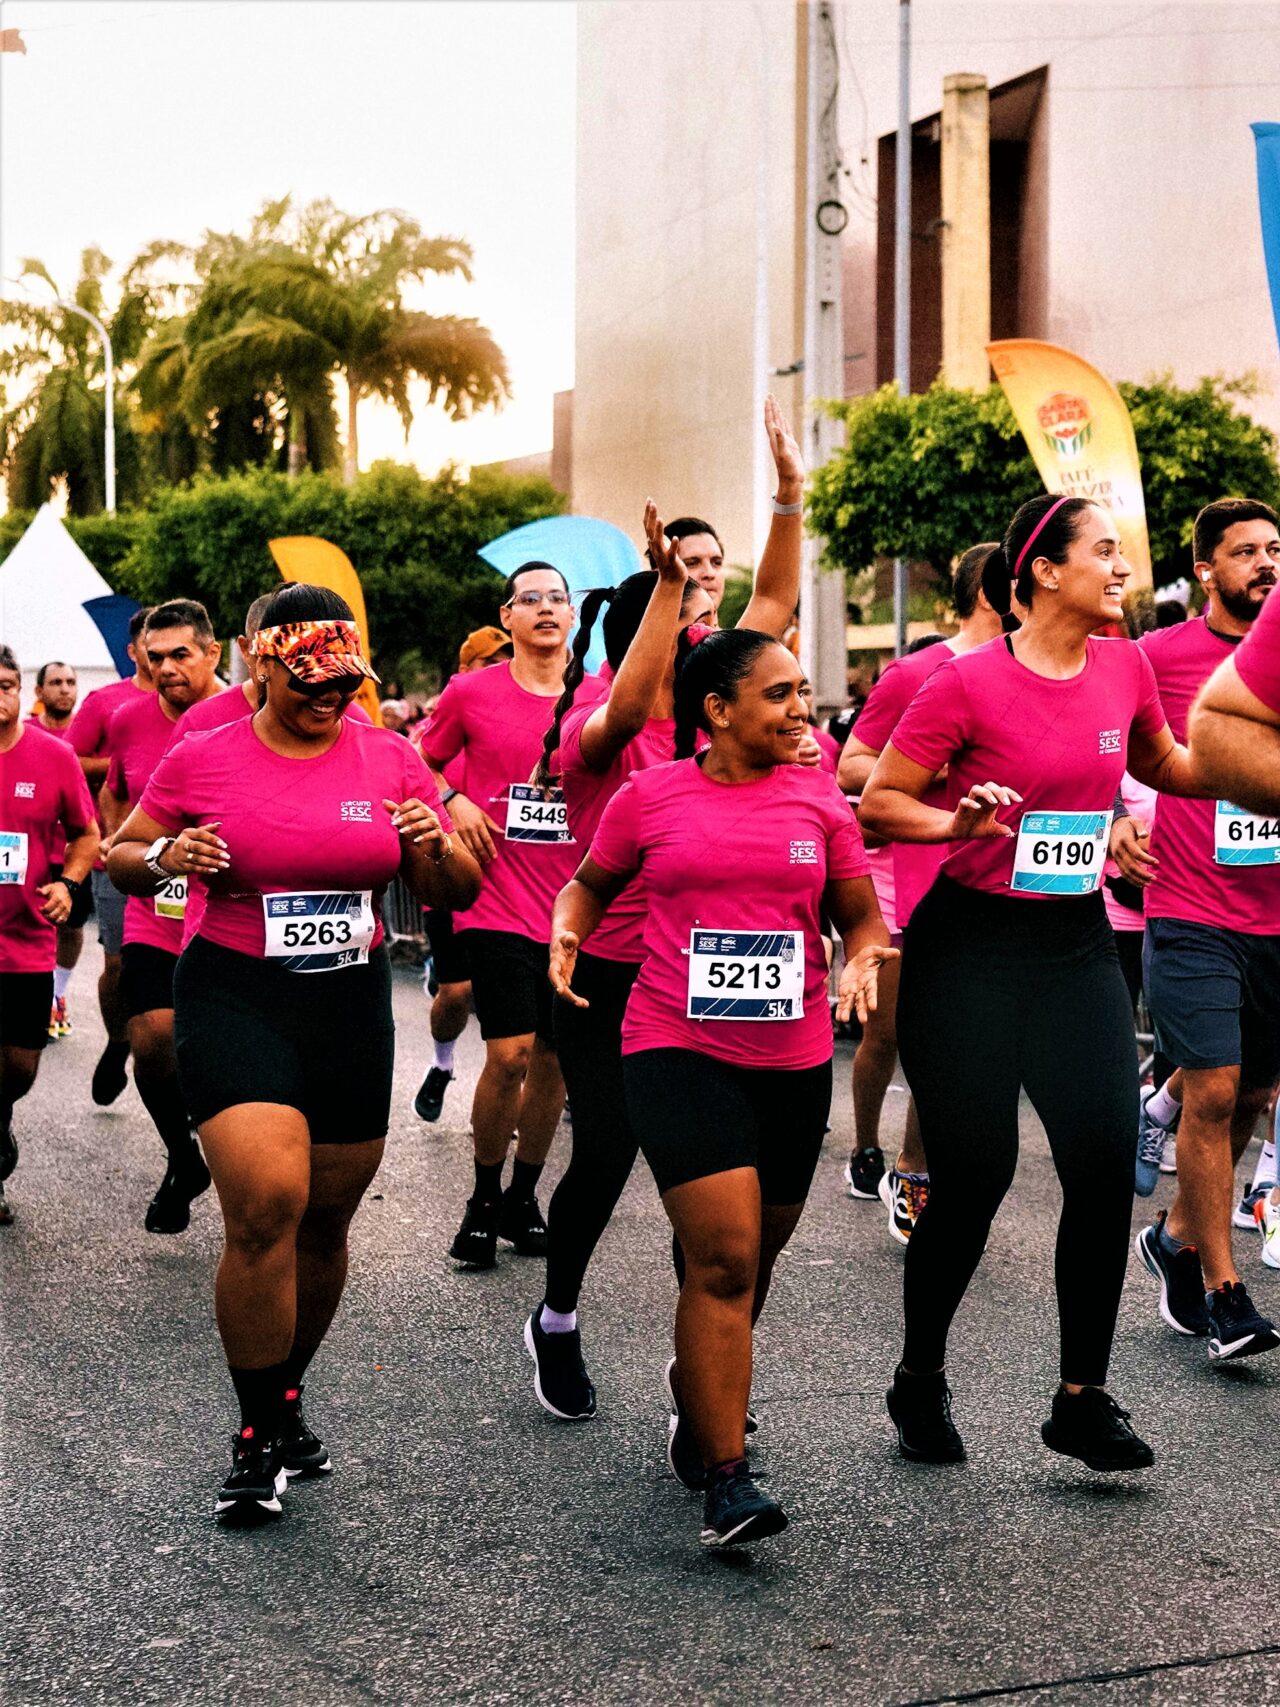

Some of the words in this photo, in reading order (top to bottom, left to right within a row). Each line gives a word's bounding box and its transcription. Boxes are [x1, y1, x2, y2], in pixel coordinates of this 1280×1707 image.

[1099, 736, 1120, 749] SESC
[340, 807, 371, 817] SESC
[520, 805, 567, 824] 5449
[790, 848, 817, 858] SESC
[1033, 841, 1094, 866] 6190
[163, 883, 189, 900] 20
[283, 921, 351, 947] 5263
[707, 963, 781, 989] 5213
